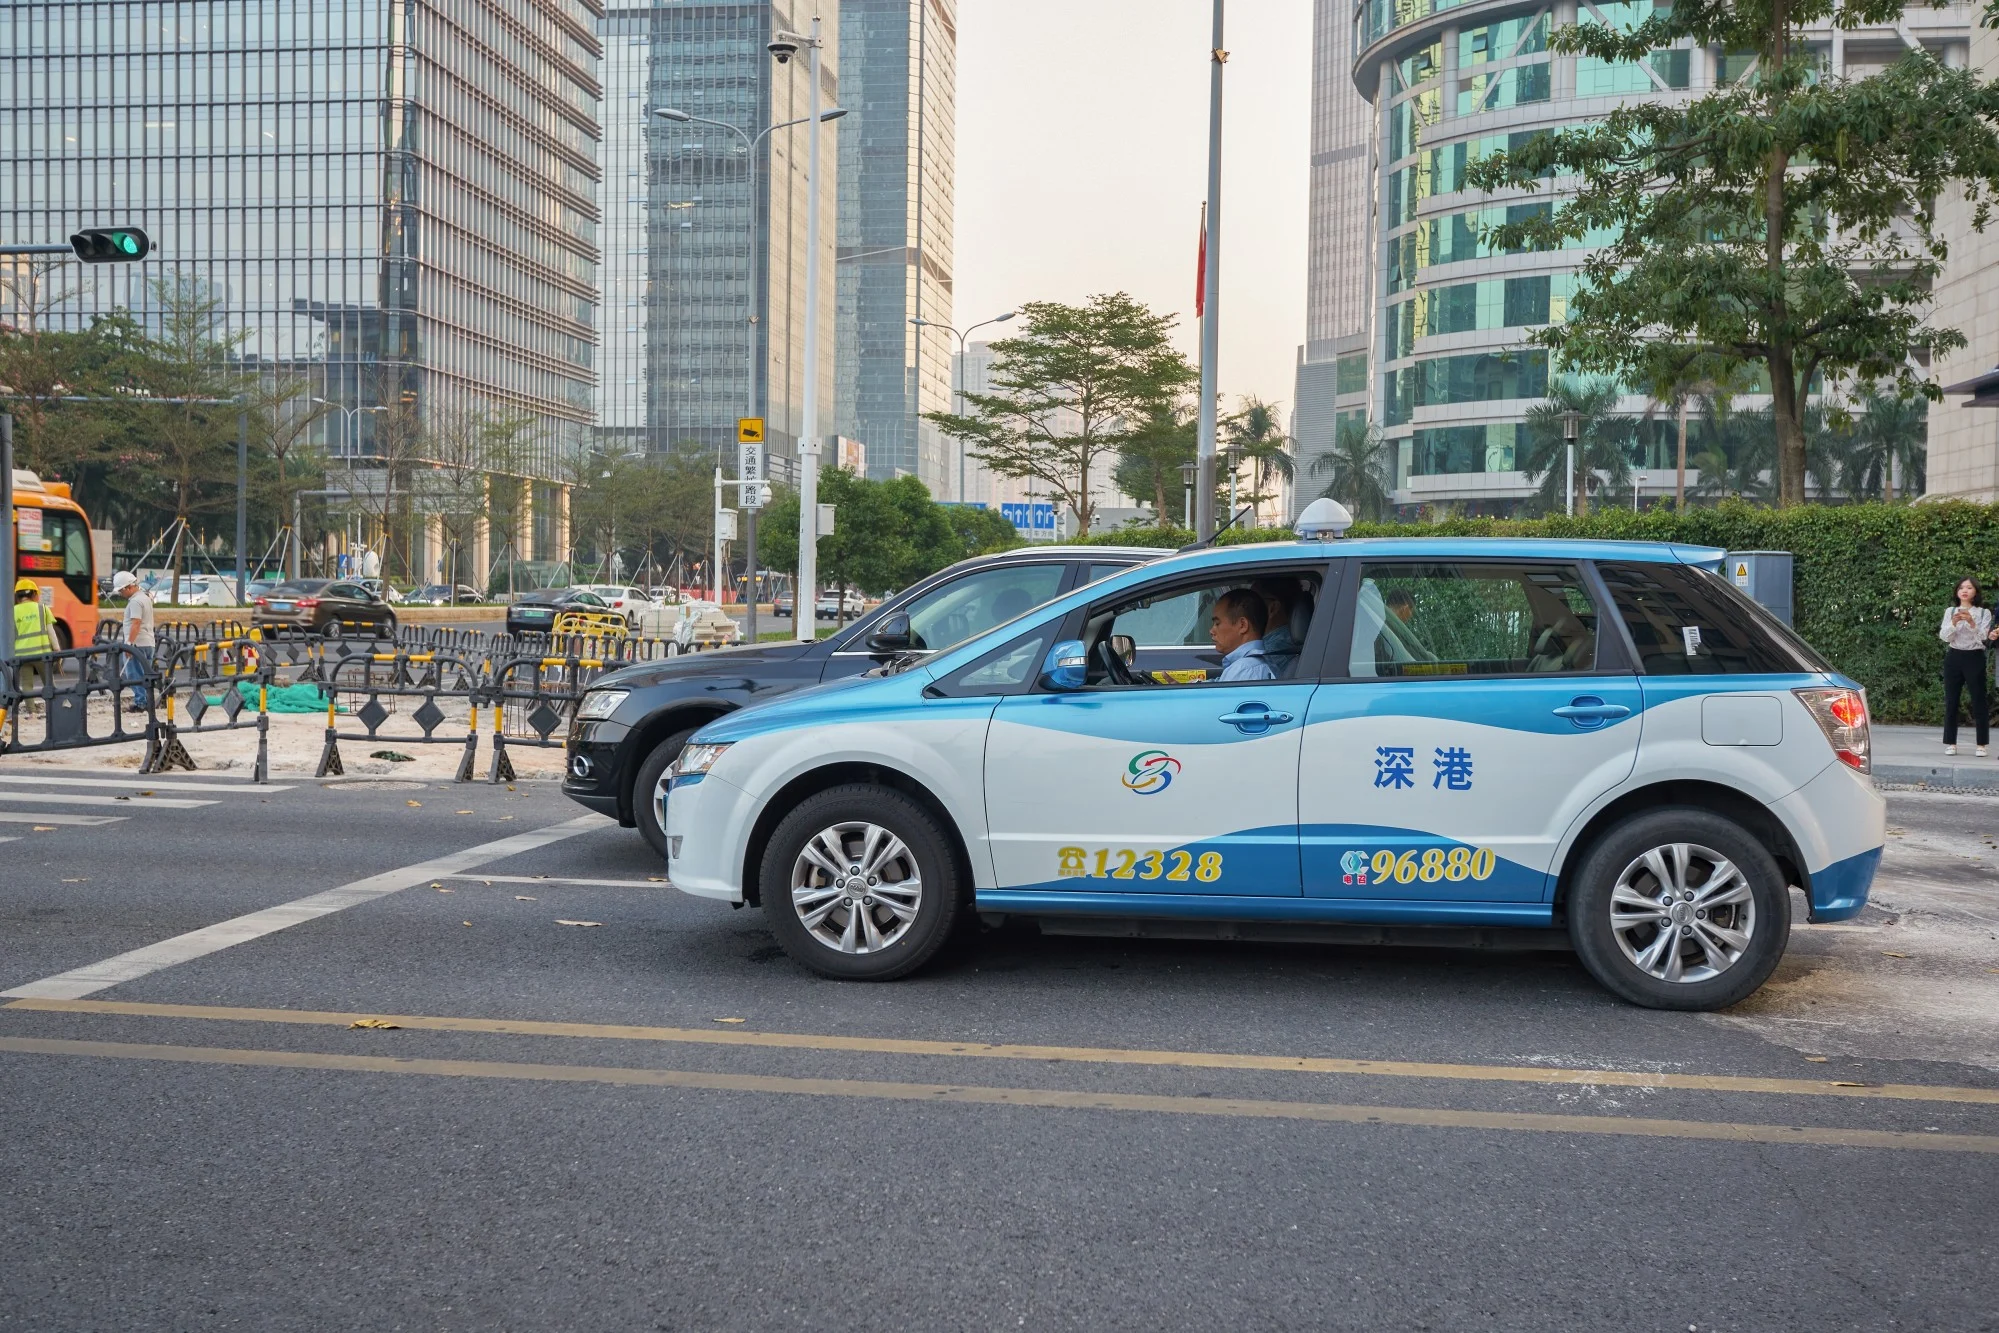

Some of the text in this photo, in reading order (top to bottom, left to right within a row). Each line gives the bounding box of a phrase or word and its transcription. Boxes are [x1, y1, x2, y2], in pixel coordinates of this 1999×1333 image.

[1373, 745, 1474, 791] 深港
[1091, 847, 1223, 882] 12328
[1343, 874, 1367, 885] 电召
[1371, 847, 1496, 884] 96880
